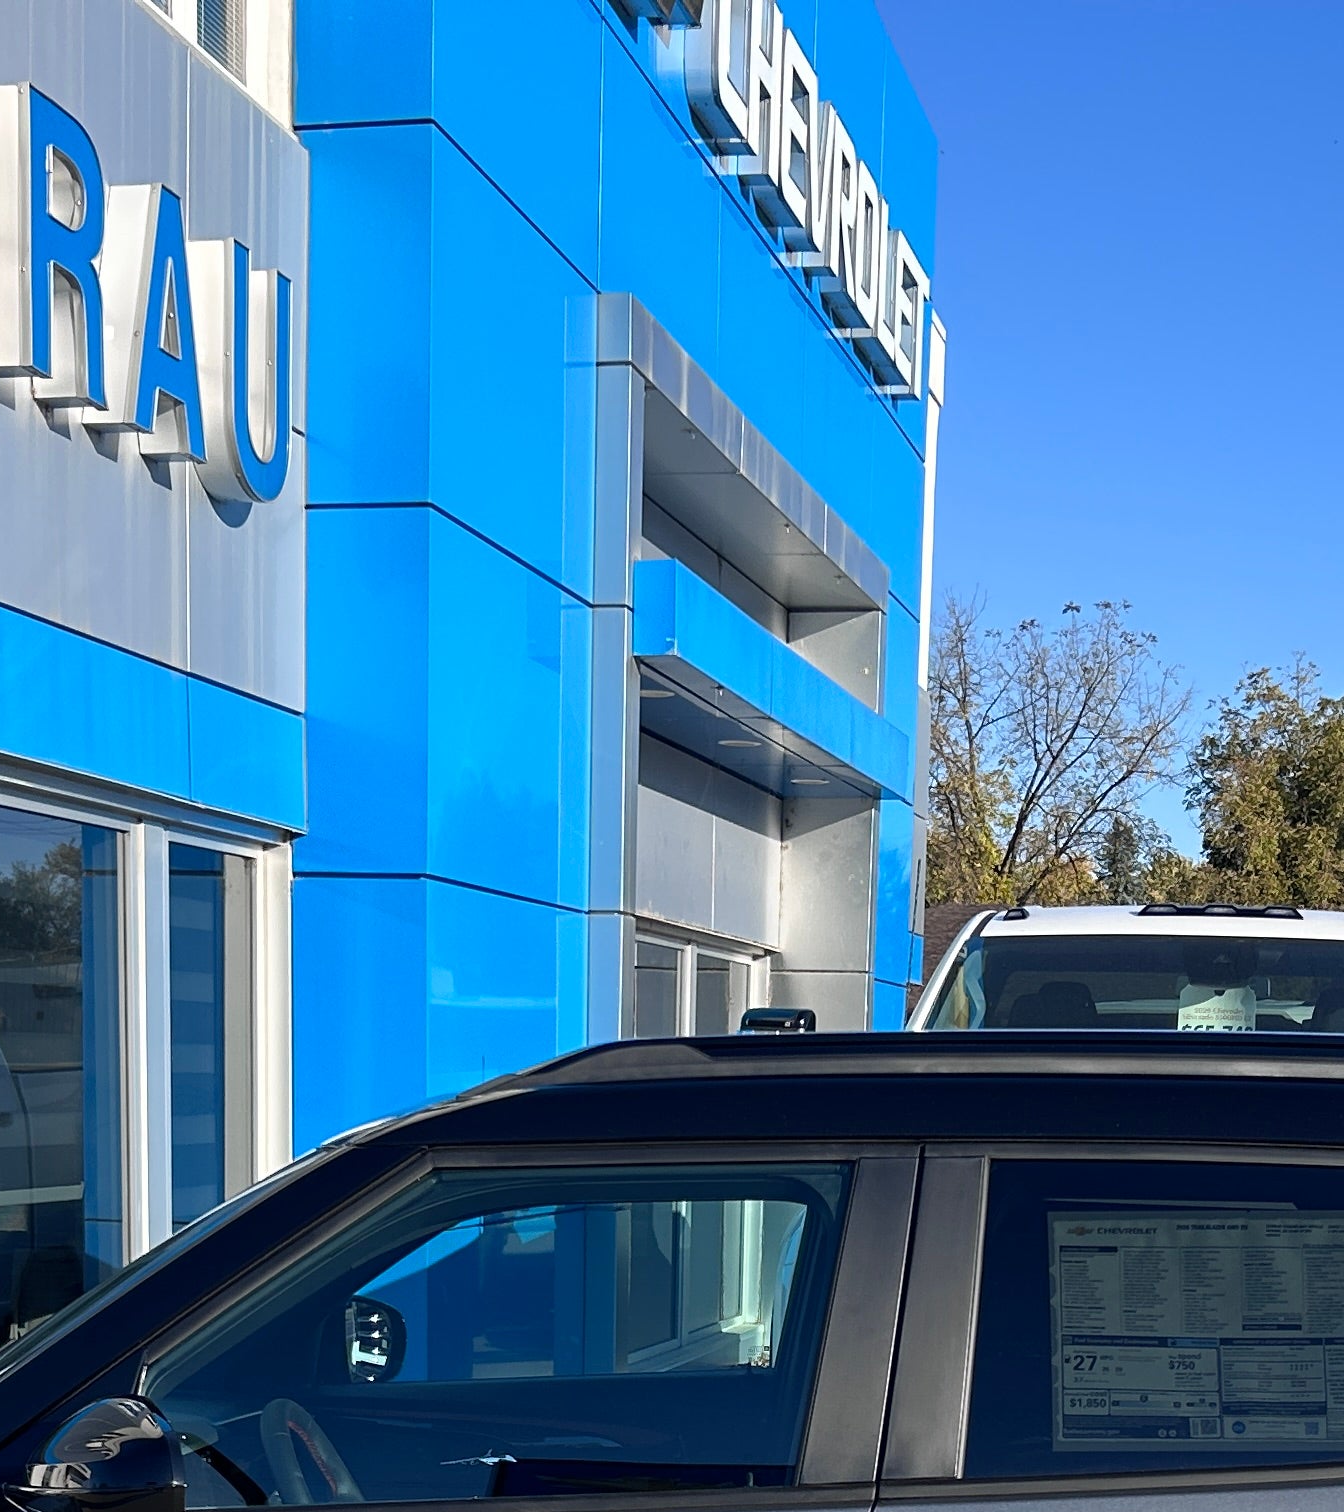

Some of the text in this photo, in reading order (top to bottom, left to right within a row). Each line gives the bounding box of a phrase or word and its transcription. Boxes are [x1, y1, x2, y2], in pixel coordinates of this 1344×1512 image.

[710, 0, 932, 402] CHEVROLET
[1096, 1227, 1158, 1235] CHEVROLET
[1073, 1355, 1097, 1371] 27
[1168, 1360, 1195, 1370] $750
[1069, 1398, 1107, 1409] $1,850
